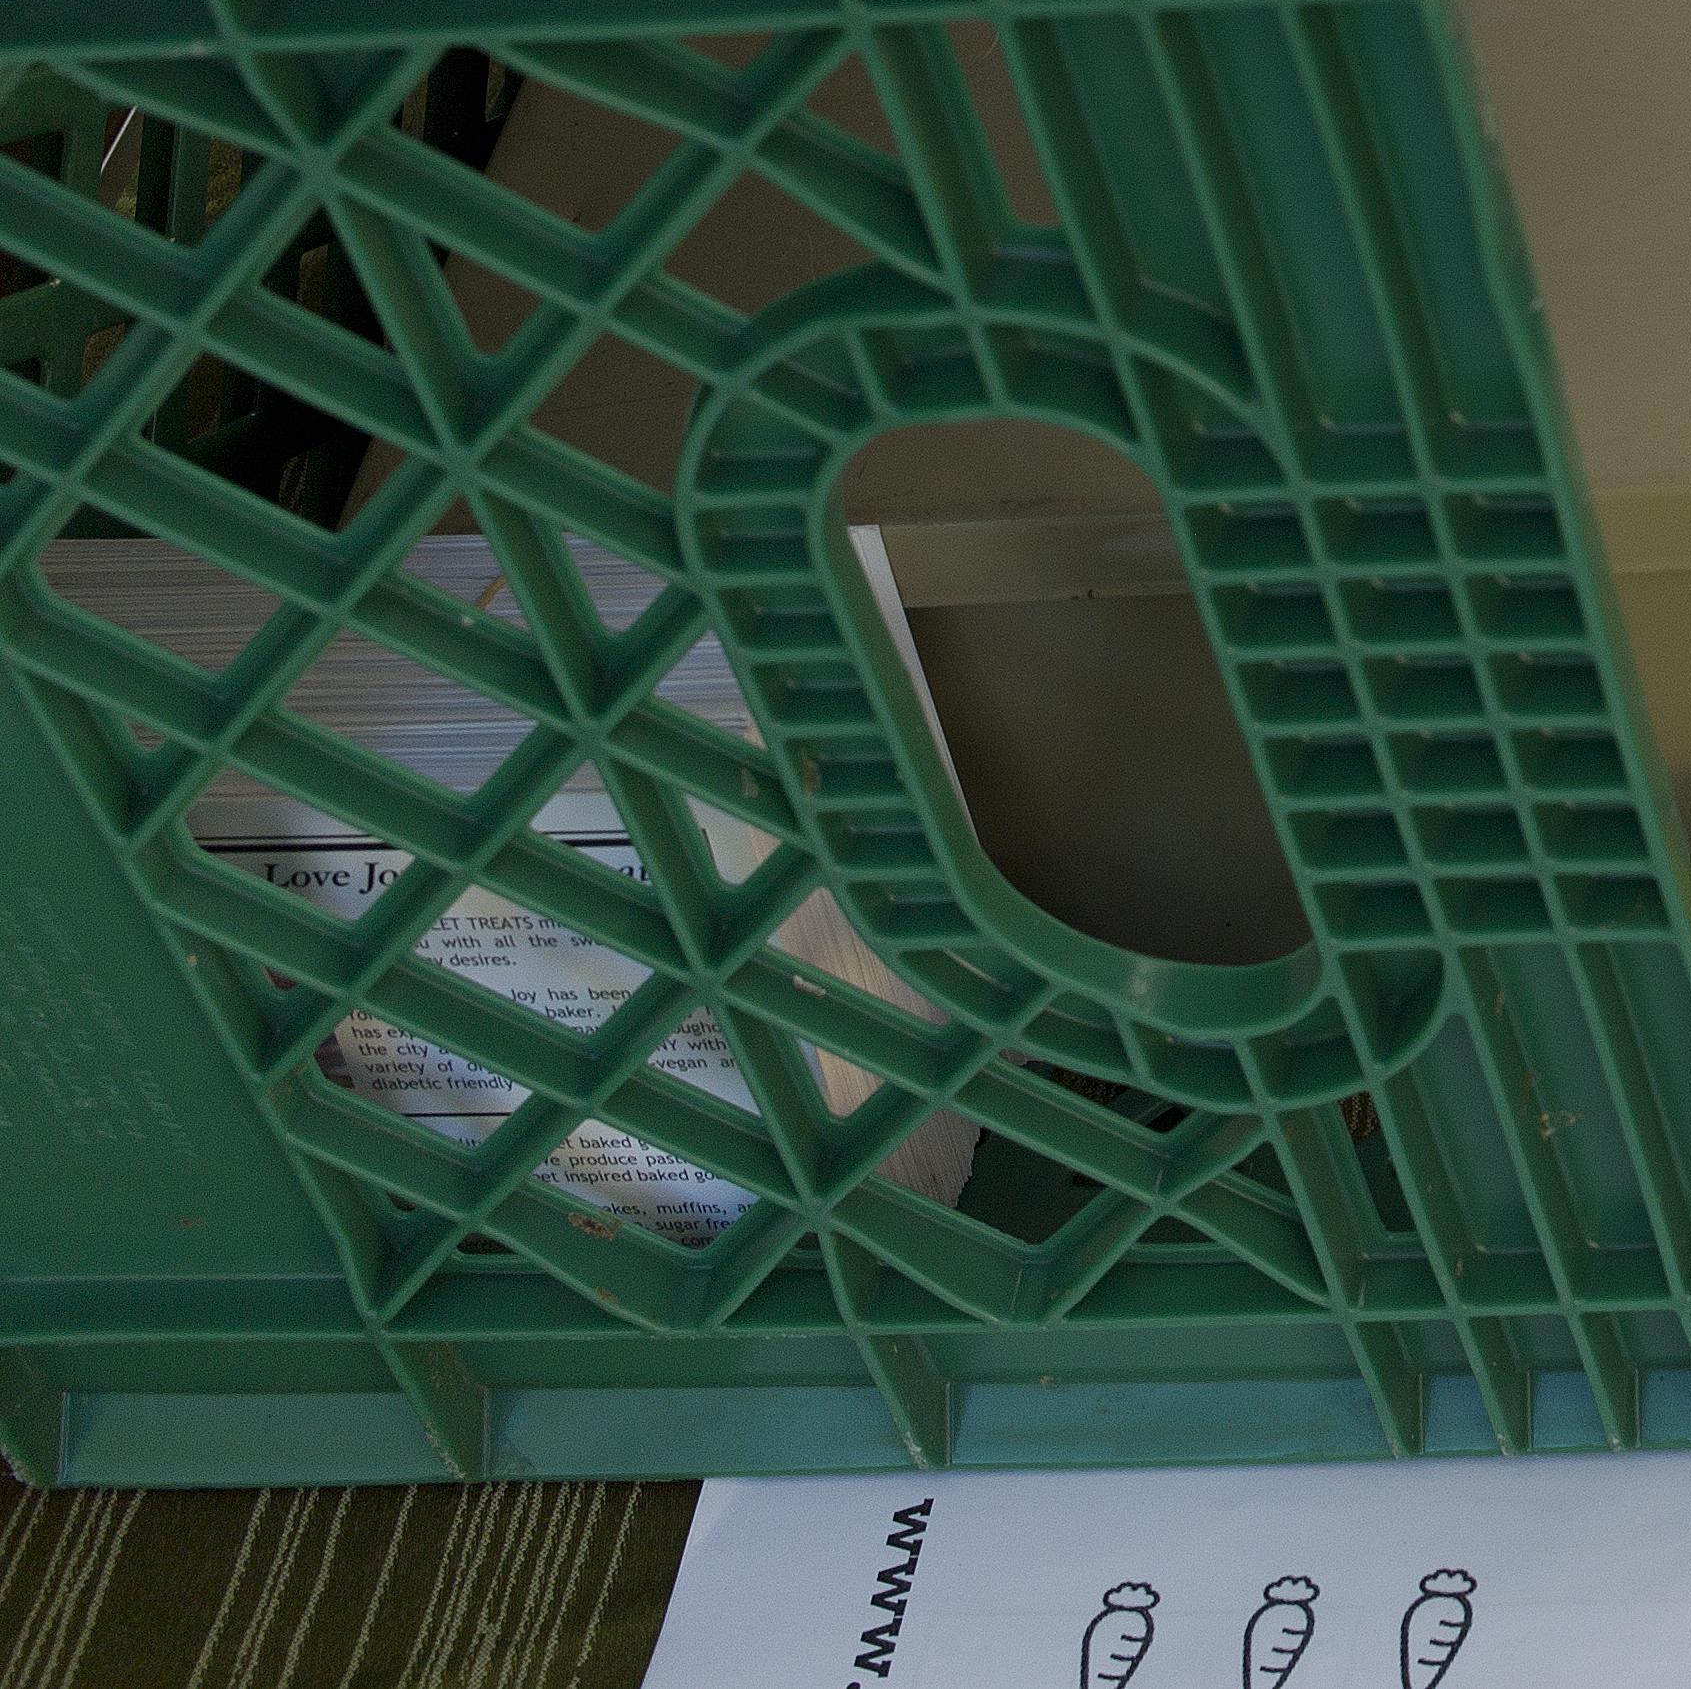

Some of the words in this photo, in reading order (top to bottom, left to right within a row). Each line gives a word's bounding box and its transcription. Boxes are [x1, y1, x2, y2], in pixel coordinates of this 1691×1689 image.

[265, 861, 352, 889] Love
[466, 915, 534, 931] TREATS
[441, 933, 482, 949] with
[494, 932, 517, 949] all
[527, 933, 558, 949] the
[448, 951, 518, 969] desires.
[546, 987, 579, 1002] has
[586, 986, 633, 1002] been
[545, 1004, 602, 1022] baker.
[350, 1025, 383, 1041] has
[357, 1042, 389, 1058] the
[395, 1042, 430, 1062] city
[686, 1037, 727, 1053] with
[362, 1059, 427, 1077] variety
[371, 1075, 444, 1092] diabetic
[446, 1075, 515, 1094] friendly
[578, 1136, 633, 1151] baked
[568, 1153, 639, 1169] produce
[563, 1169, 633, 1186] inspired
[637, 1169, 691, 1183] baked
[655, 1201, 728, 1217] muffins,
[654, 1218, 700, 1234] sugar
